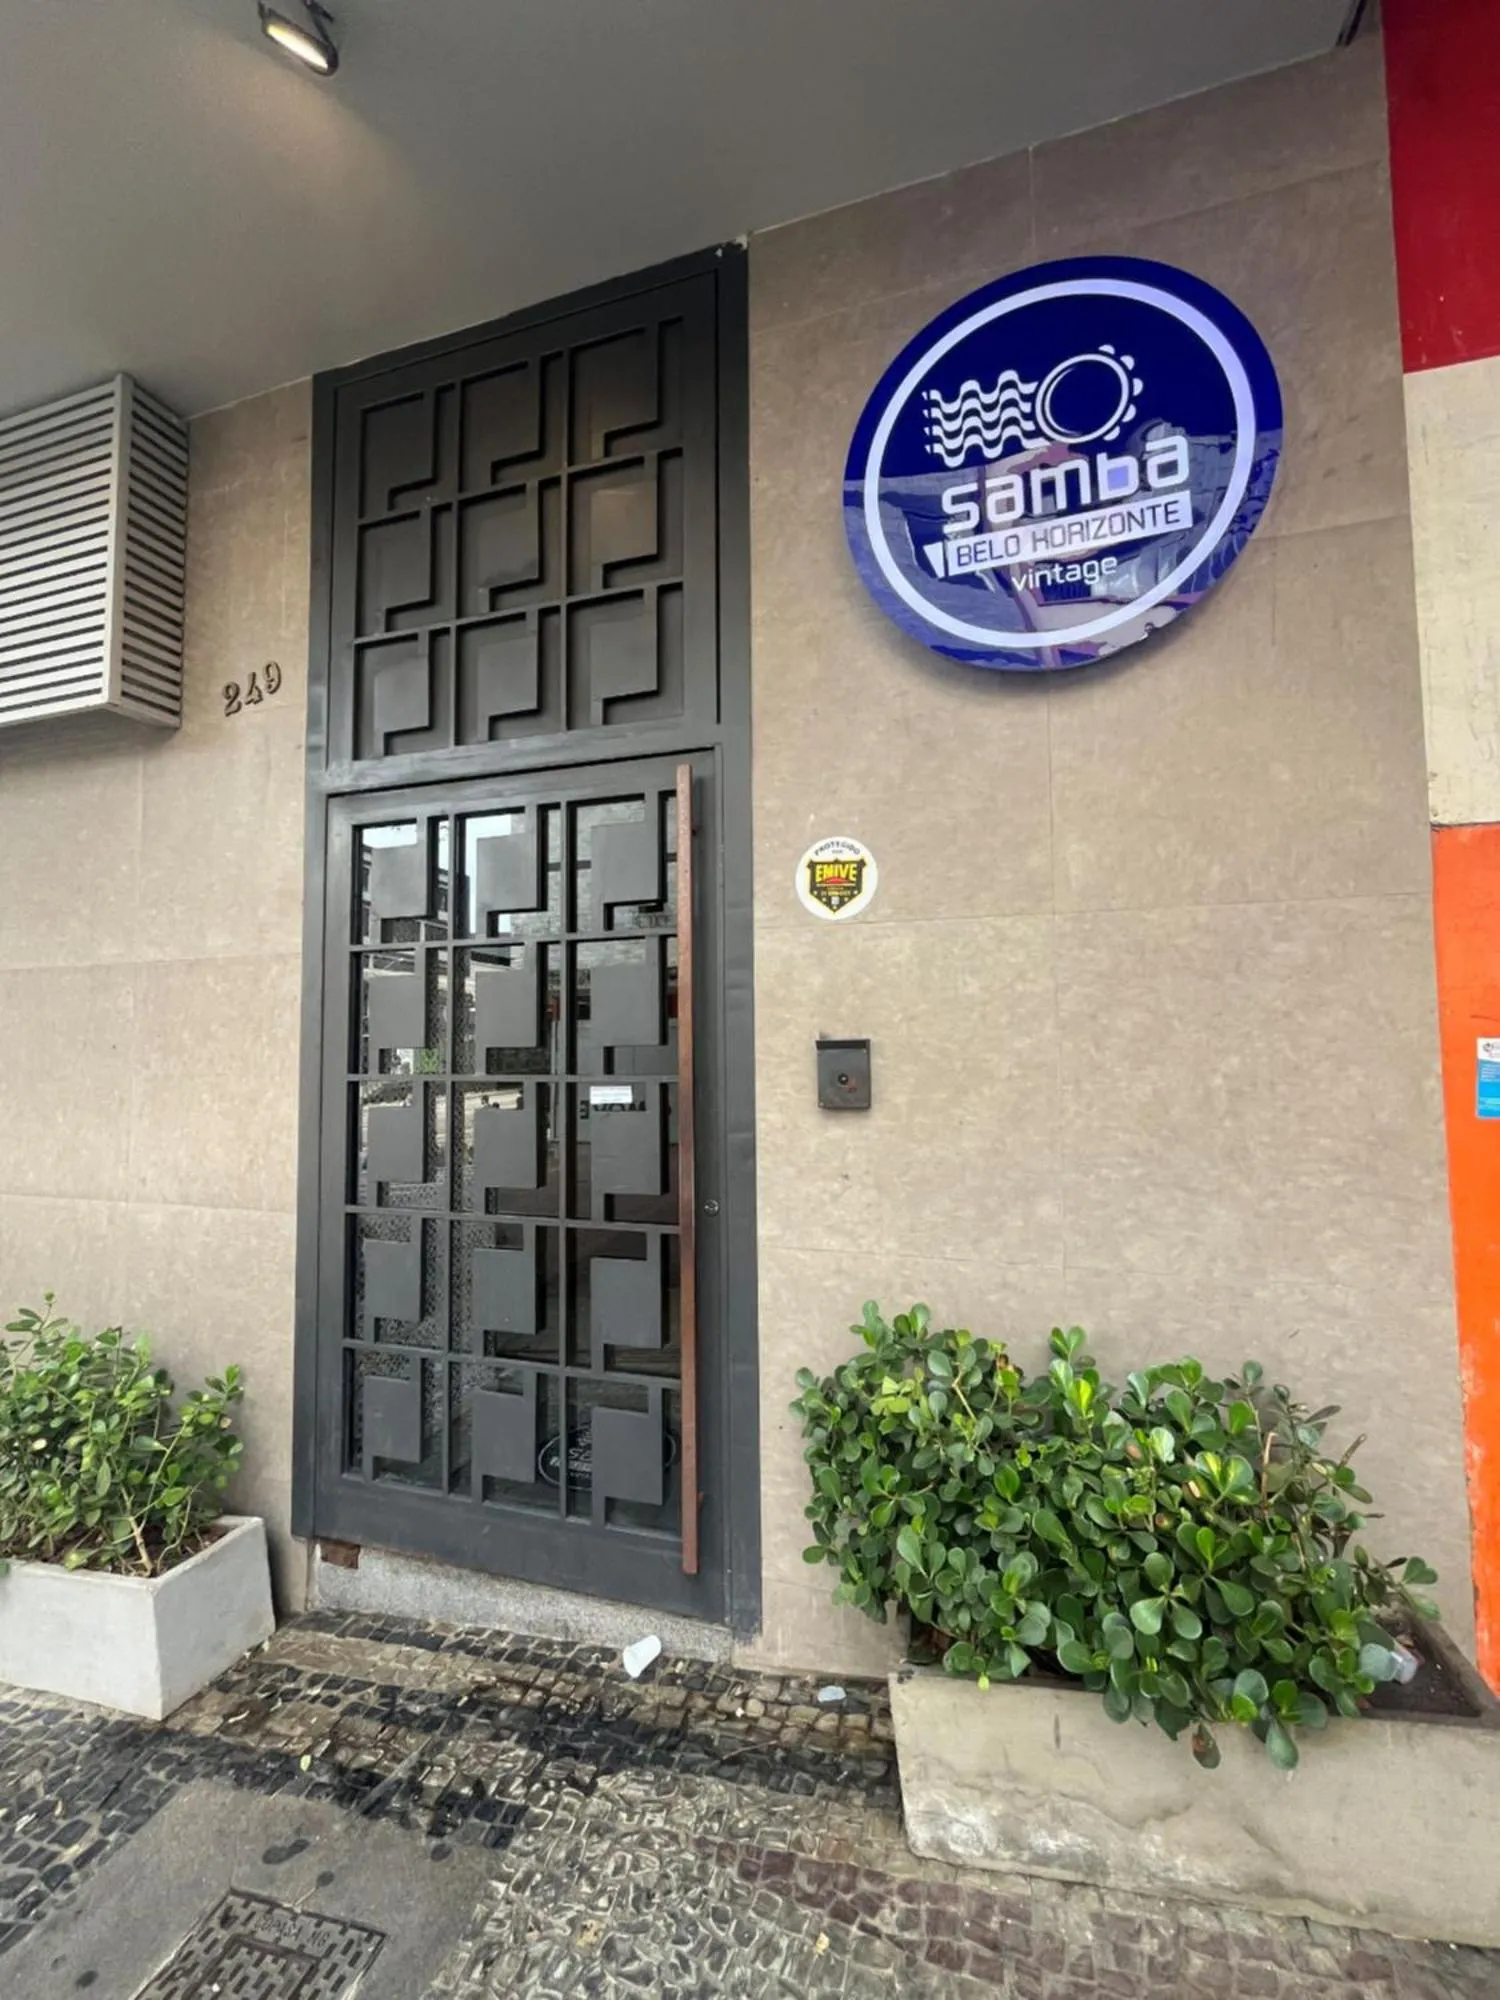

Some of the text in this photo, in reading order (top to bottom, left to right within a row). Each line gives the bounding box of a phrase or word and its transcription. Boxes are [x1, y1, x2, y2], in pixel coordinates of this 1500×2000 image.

[942, 435, 1190, 534] samba
[957, 500, 1180, 567] BELO HORIZONTE
[1012, 556, 1117, 591] vintage
[222, 660, 282, 718] 249
[815, 863, 857, 883] EMIVE
